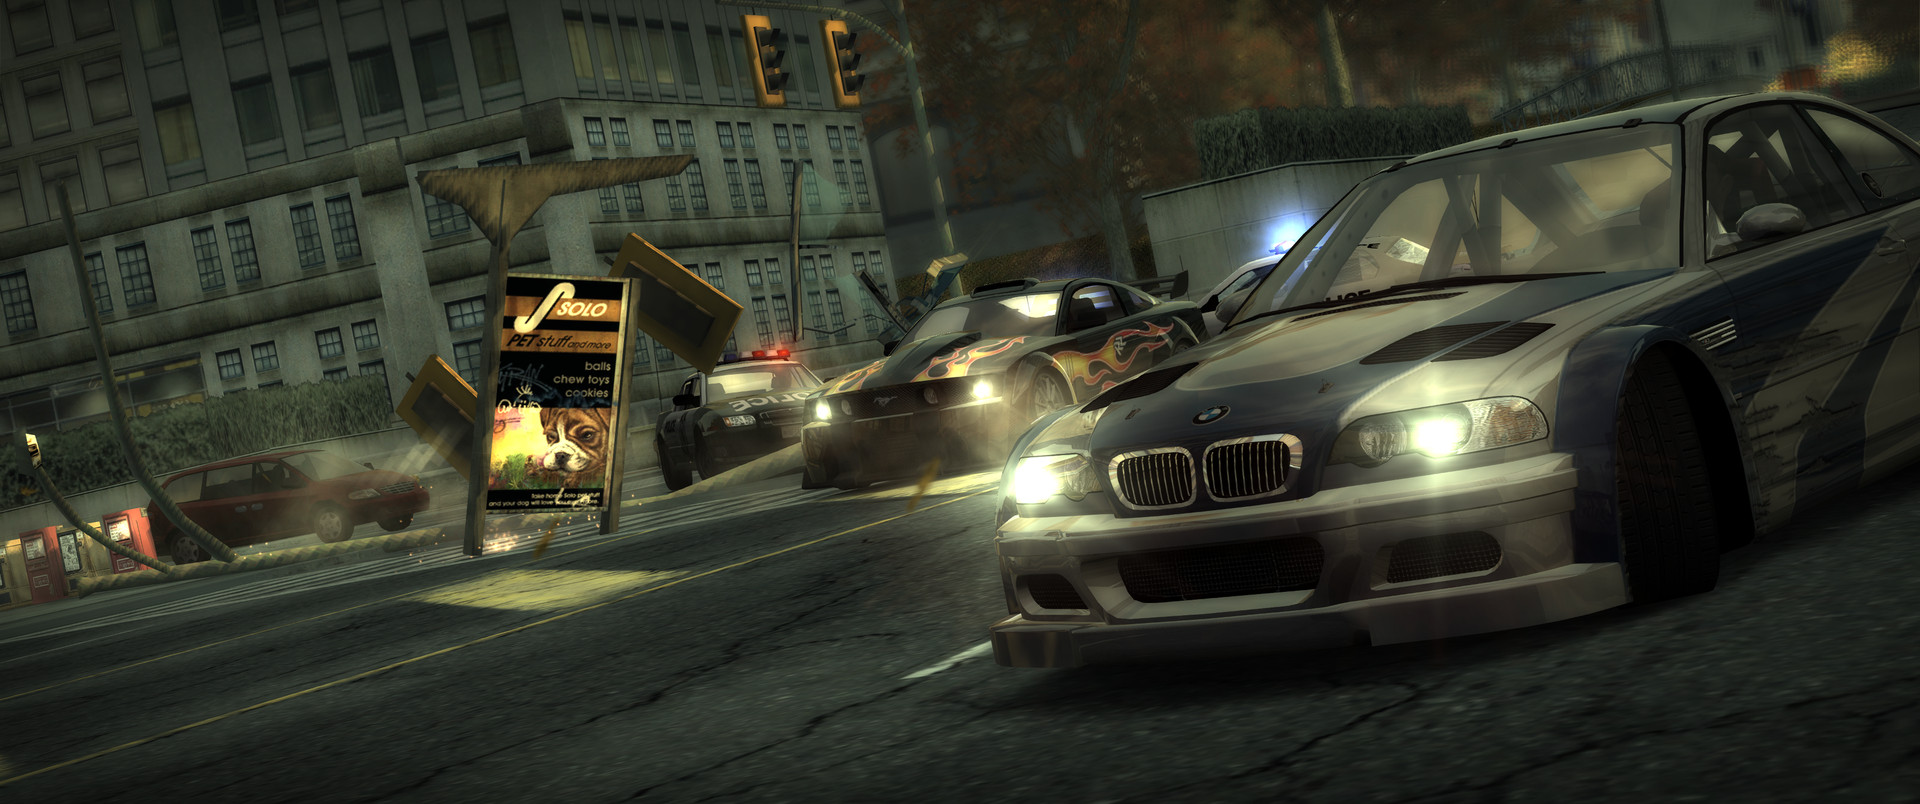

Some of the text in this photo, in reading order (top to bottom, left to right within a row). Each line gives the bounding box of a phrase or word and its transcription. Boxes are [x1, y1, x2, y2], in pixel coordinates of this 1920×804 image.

[557, 302, 608, 317] SOLO
[506, 334, 611, 349] PET stuff and more
[585, 361, 611, 371] balls
[553, 375, 610, 386] chew toys
[565, 388, 609, 398] cookies
